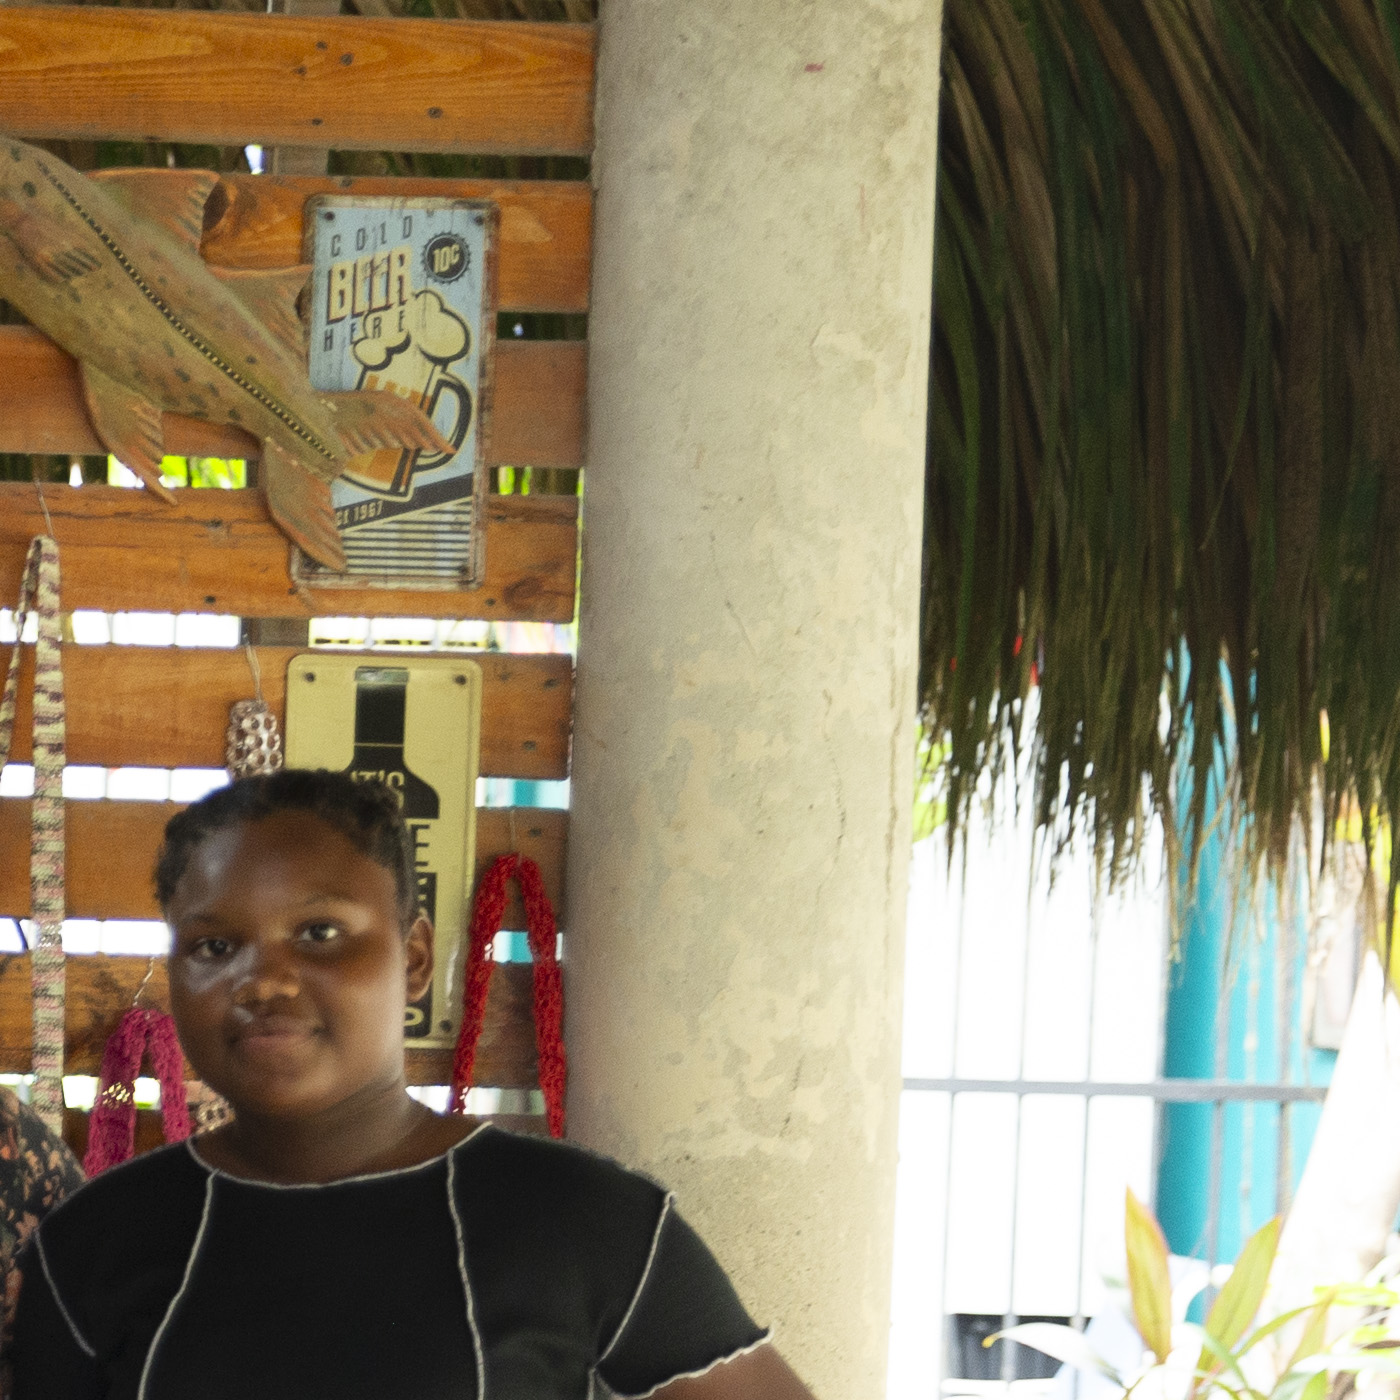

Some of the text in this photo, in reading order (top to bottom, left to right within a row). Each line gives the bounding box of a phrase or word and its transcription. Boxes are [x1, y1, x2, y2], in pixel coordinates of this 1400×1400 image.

[331, 215, 413, 258] COLD
[326, 245, 414, 325] BEER
[324, 310, 406, 352] HERE
